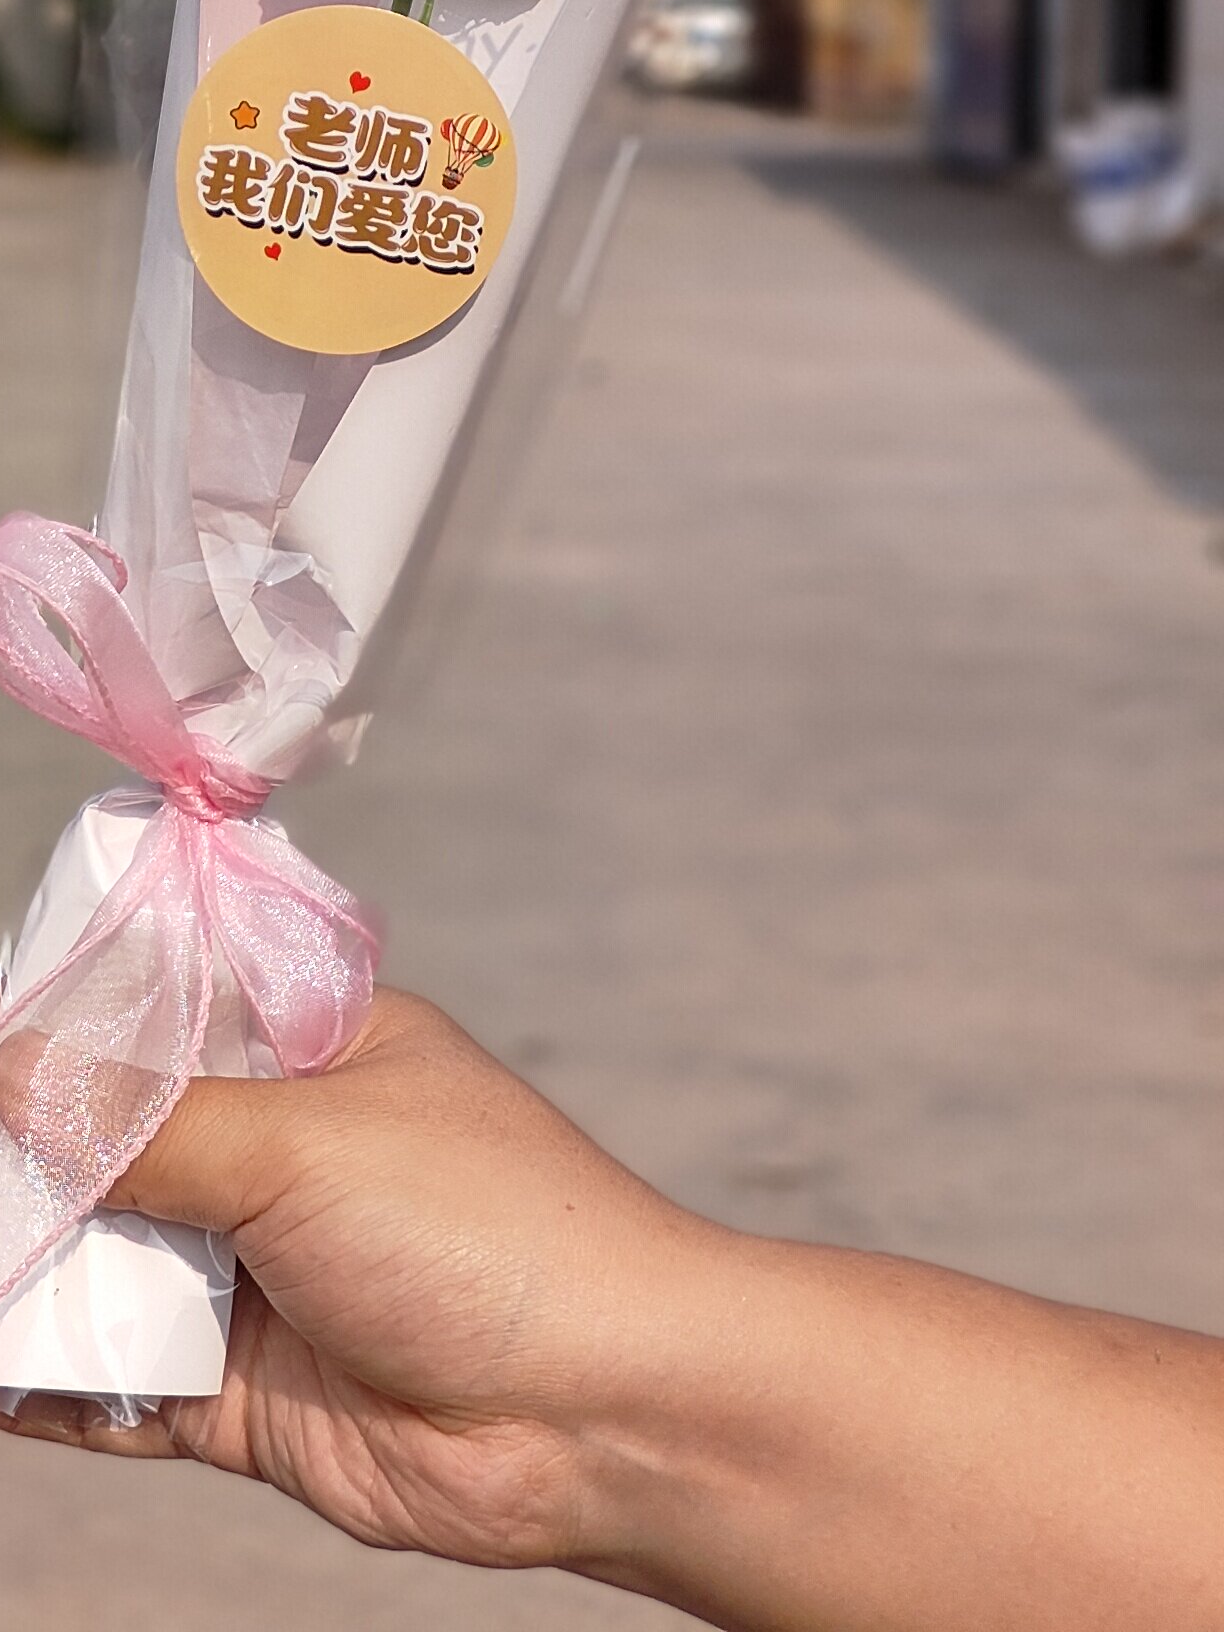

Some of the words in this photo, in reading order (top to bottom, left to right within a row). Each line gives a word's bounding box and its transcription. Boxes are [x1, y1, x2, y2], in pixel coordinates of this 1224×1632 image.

[279, 91, 433, 187] 老师
[196, 144, 484, 275] 我们爱您
